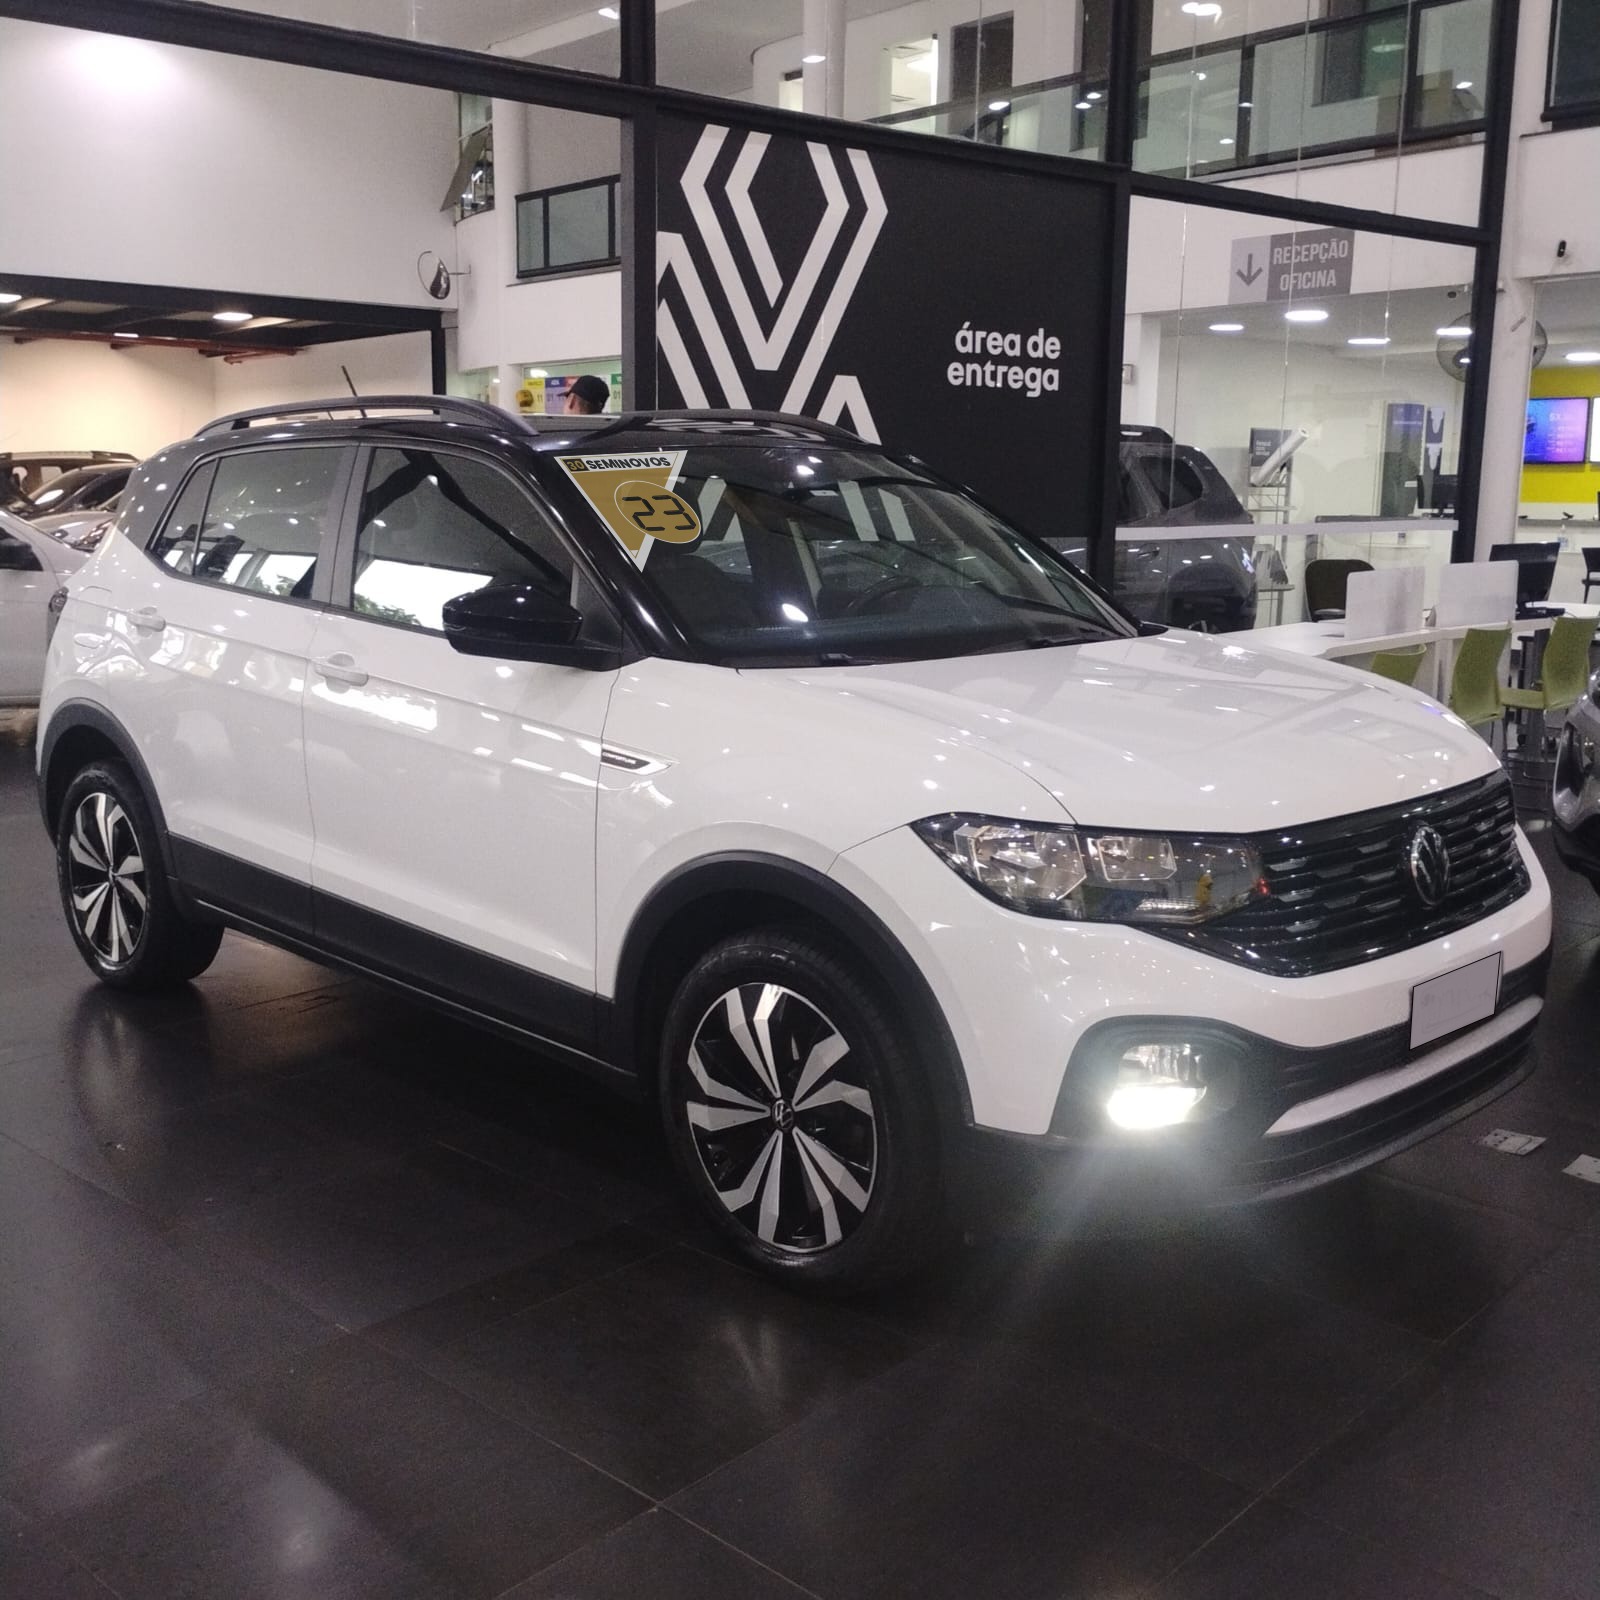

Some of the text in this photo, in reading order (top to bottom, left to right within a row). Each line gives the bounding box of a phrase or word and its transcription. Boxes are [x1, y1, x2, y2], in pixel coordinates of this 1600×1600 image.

[1273, 238, 1349, 264] RECEPÇÃO
[1280, 269, 1337, 291] OFICINA
[955, 321, 1061, 360] área de
[947, 360, 1060, 398] entrega
[566, 457, 671, 471] 30 SEMINOVOS
[622, 494, 697, 531] 23
